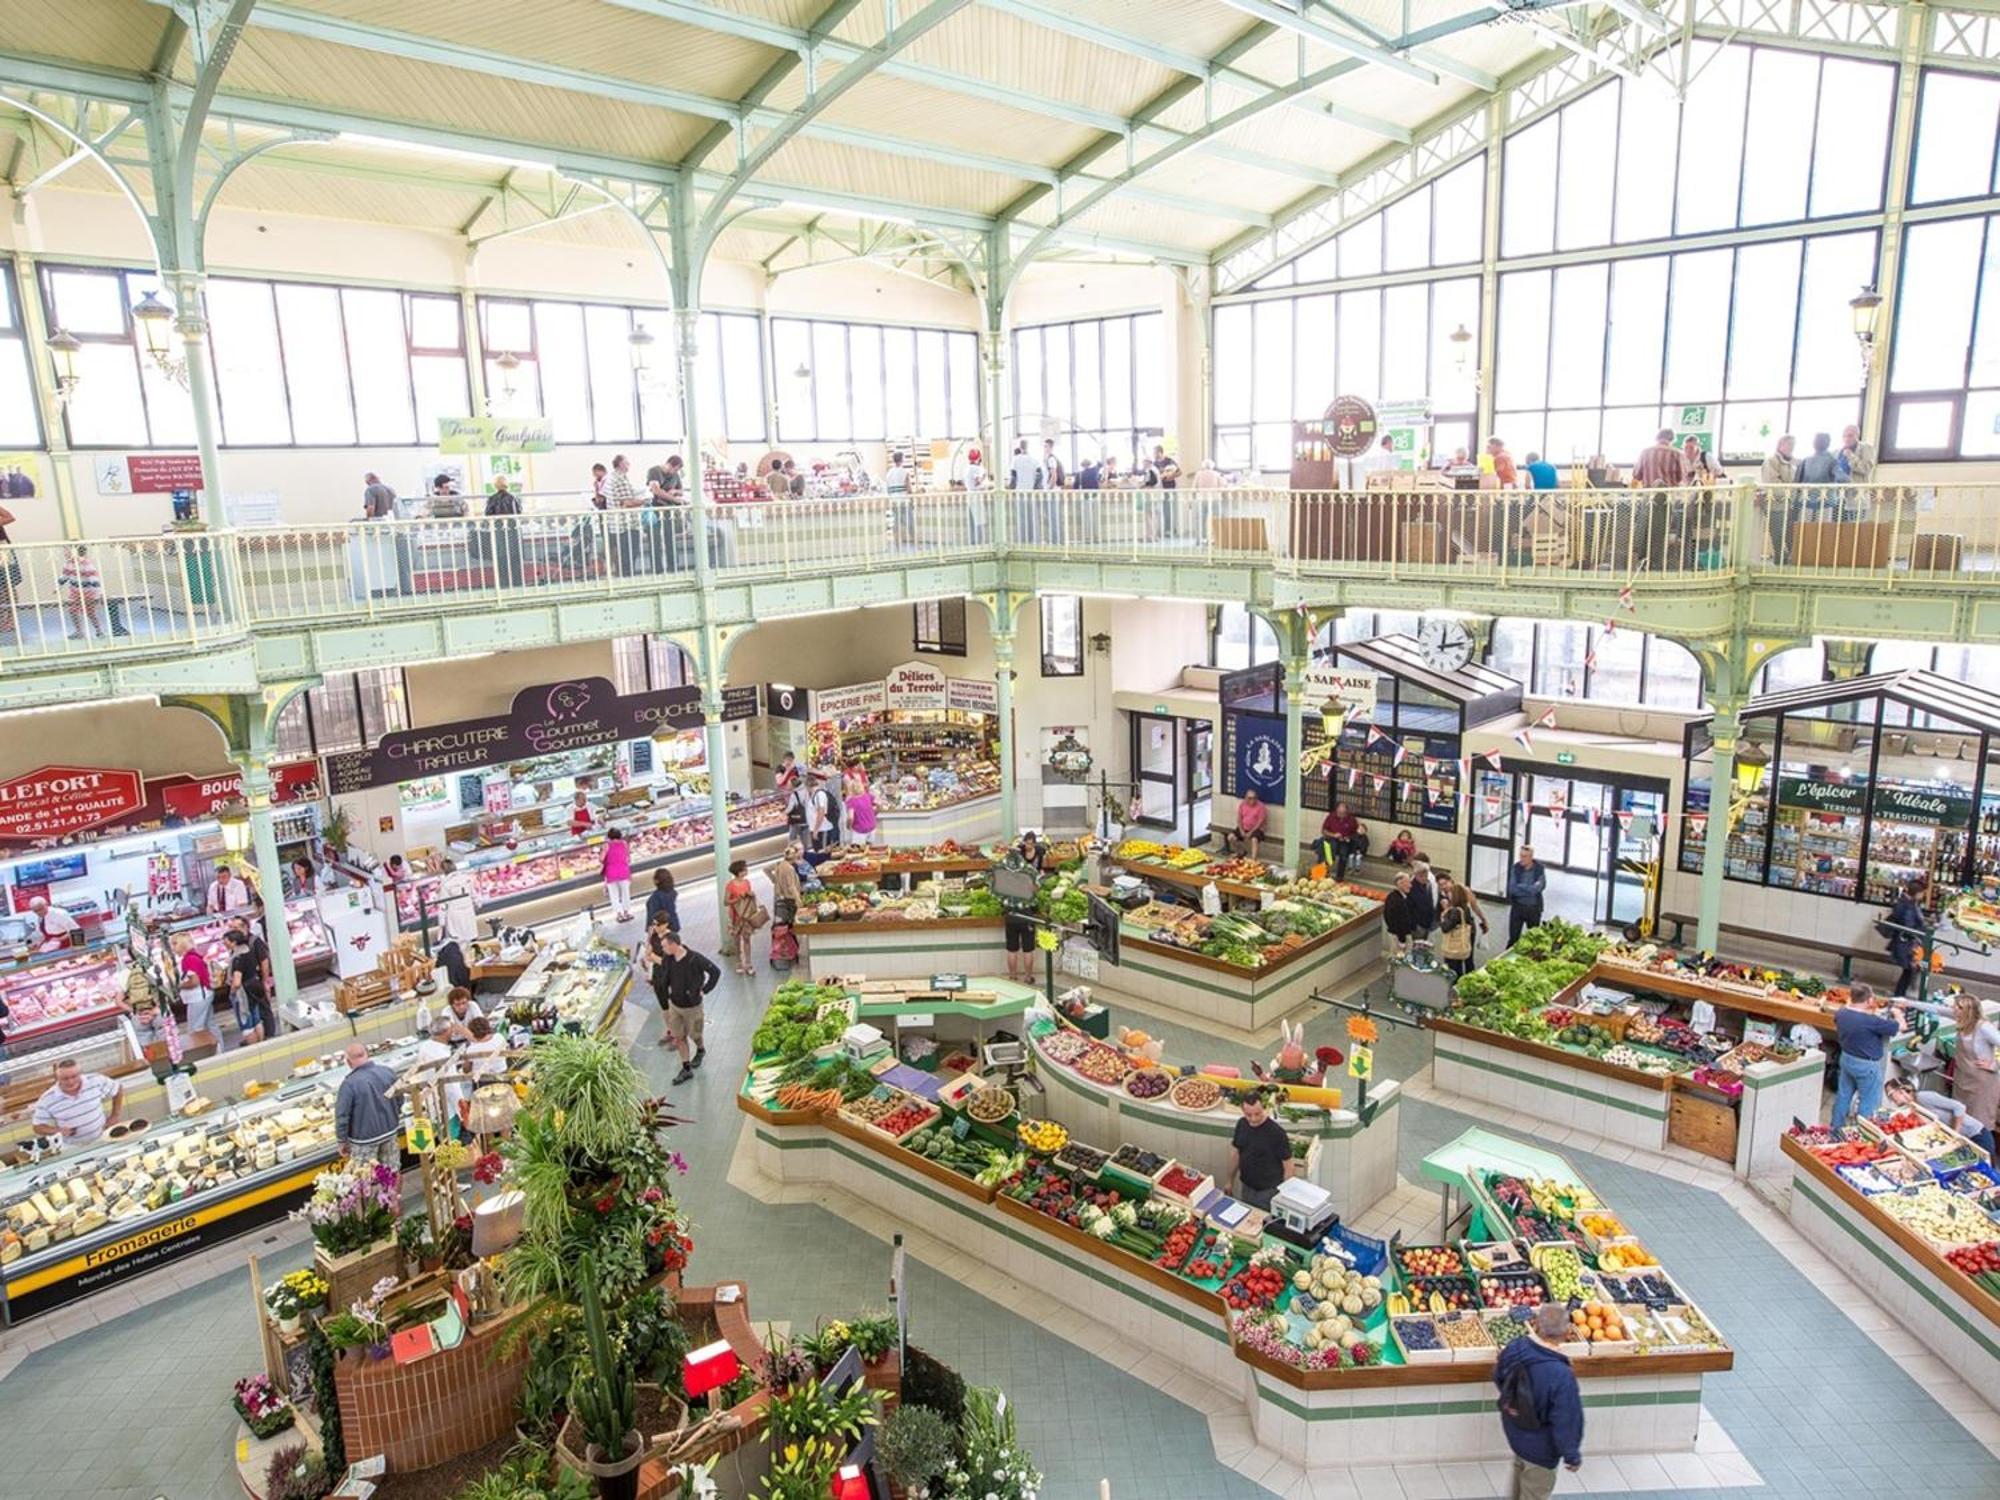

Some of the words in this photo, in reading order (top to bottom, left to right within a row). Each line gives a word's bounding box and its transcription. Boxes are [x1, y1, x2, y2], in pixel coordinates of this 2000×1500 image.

[889, 683, 903, 694] du
[906, 682, 945, 693] Terroir
[899, 671, 935, 682] Délices
[863, 692, 883, 704] FINE
[387, 725, 509, 759] CHARCUTERIE
[525, 719, 599, 741] Gourmet
[533, 727, 618, 752] Gourmand
[415, 748, 488, 772] TRAITEUR
[0, 772, 103, 802] LEFORT
[35, 809, 50, 820] de
[75, 796, 125, 812] QUALITÉ
[1882, 810, 1941, 826] TRADITIONS
[85, 1216, 197, 1267] Fromagerie
[78, 1267, 112, 1288] Marché
[114, 1261, 130, 1274] des
[132, 1250, 159, 1267] Halles
[161, 1234, 201, 1255] Centrales
